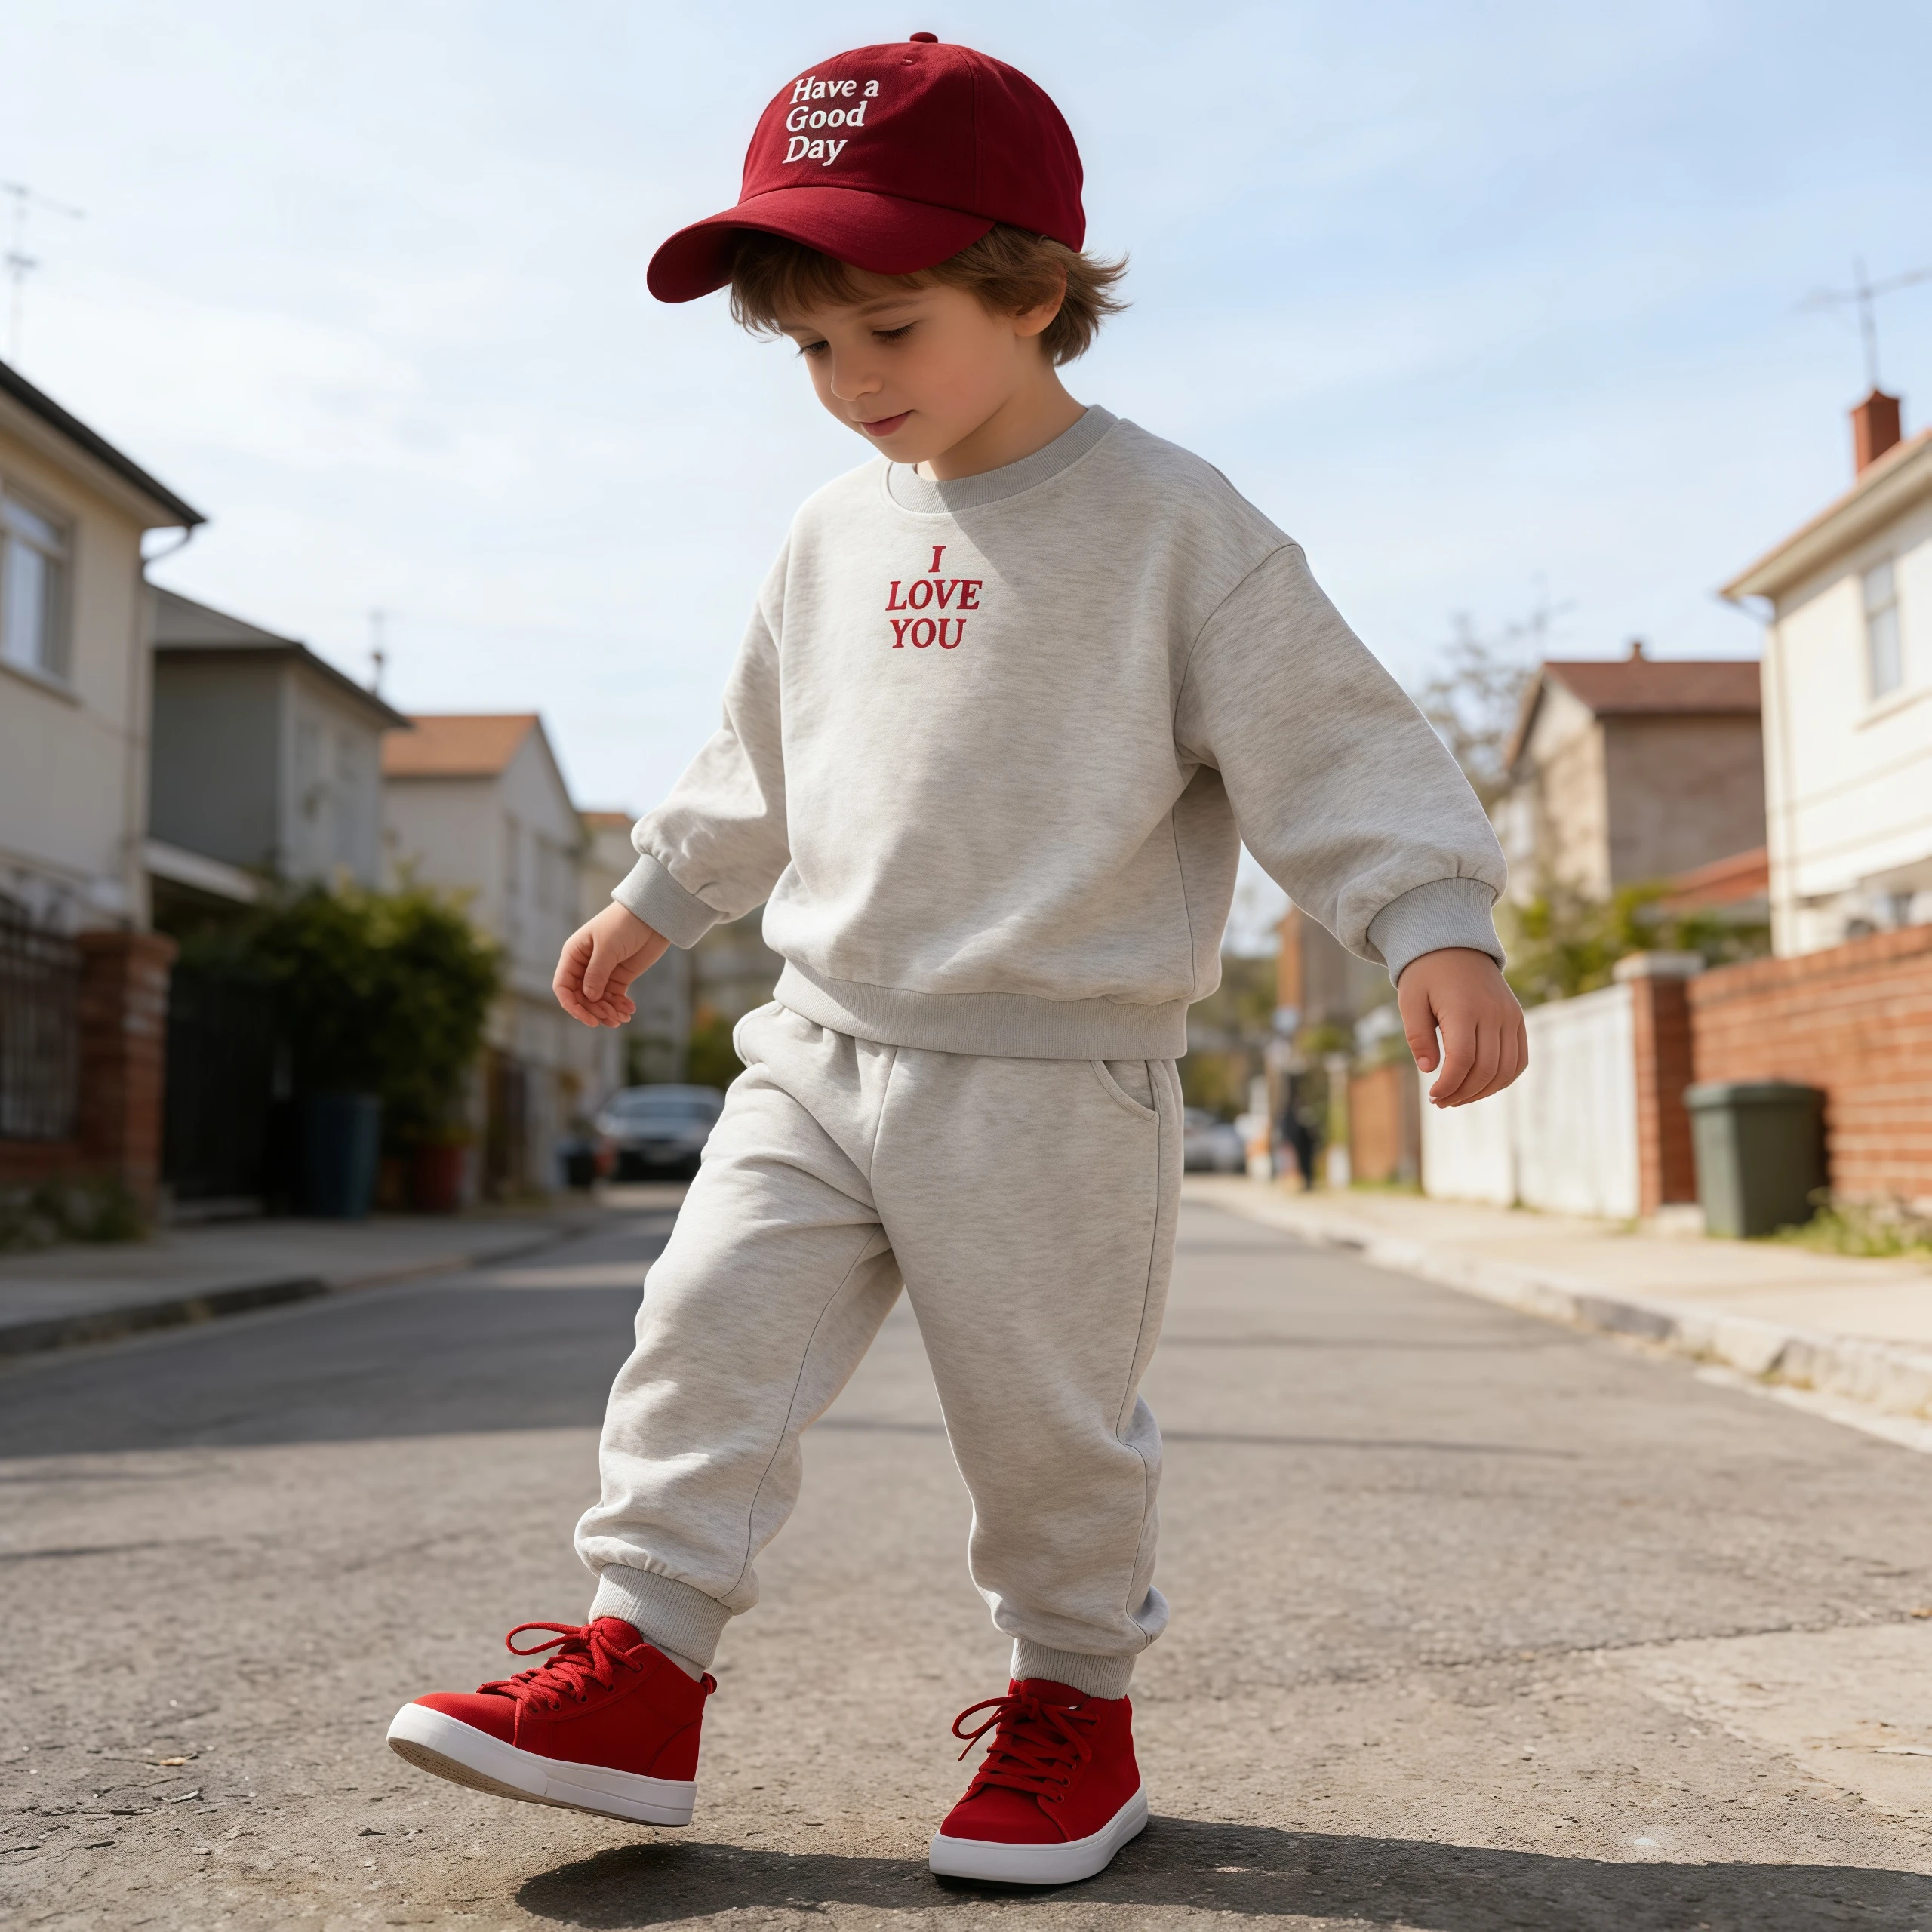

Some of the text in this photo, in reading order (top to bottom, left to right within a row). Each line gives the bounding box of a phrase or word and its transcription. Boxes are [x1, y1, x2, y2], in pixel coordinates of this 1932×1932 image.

[789, 76, 880, 104] Have a
[786, 100, 868, 132] Good
[782, 135, 848, 167] Day
[928, 545, 946, 573] I
[885, 579, 983, 611] LOVE
[890, 617, 967, 649] YOU
